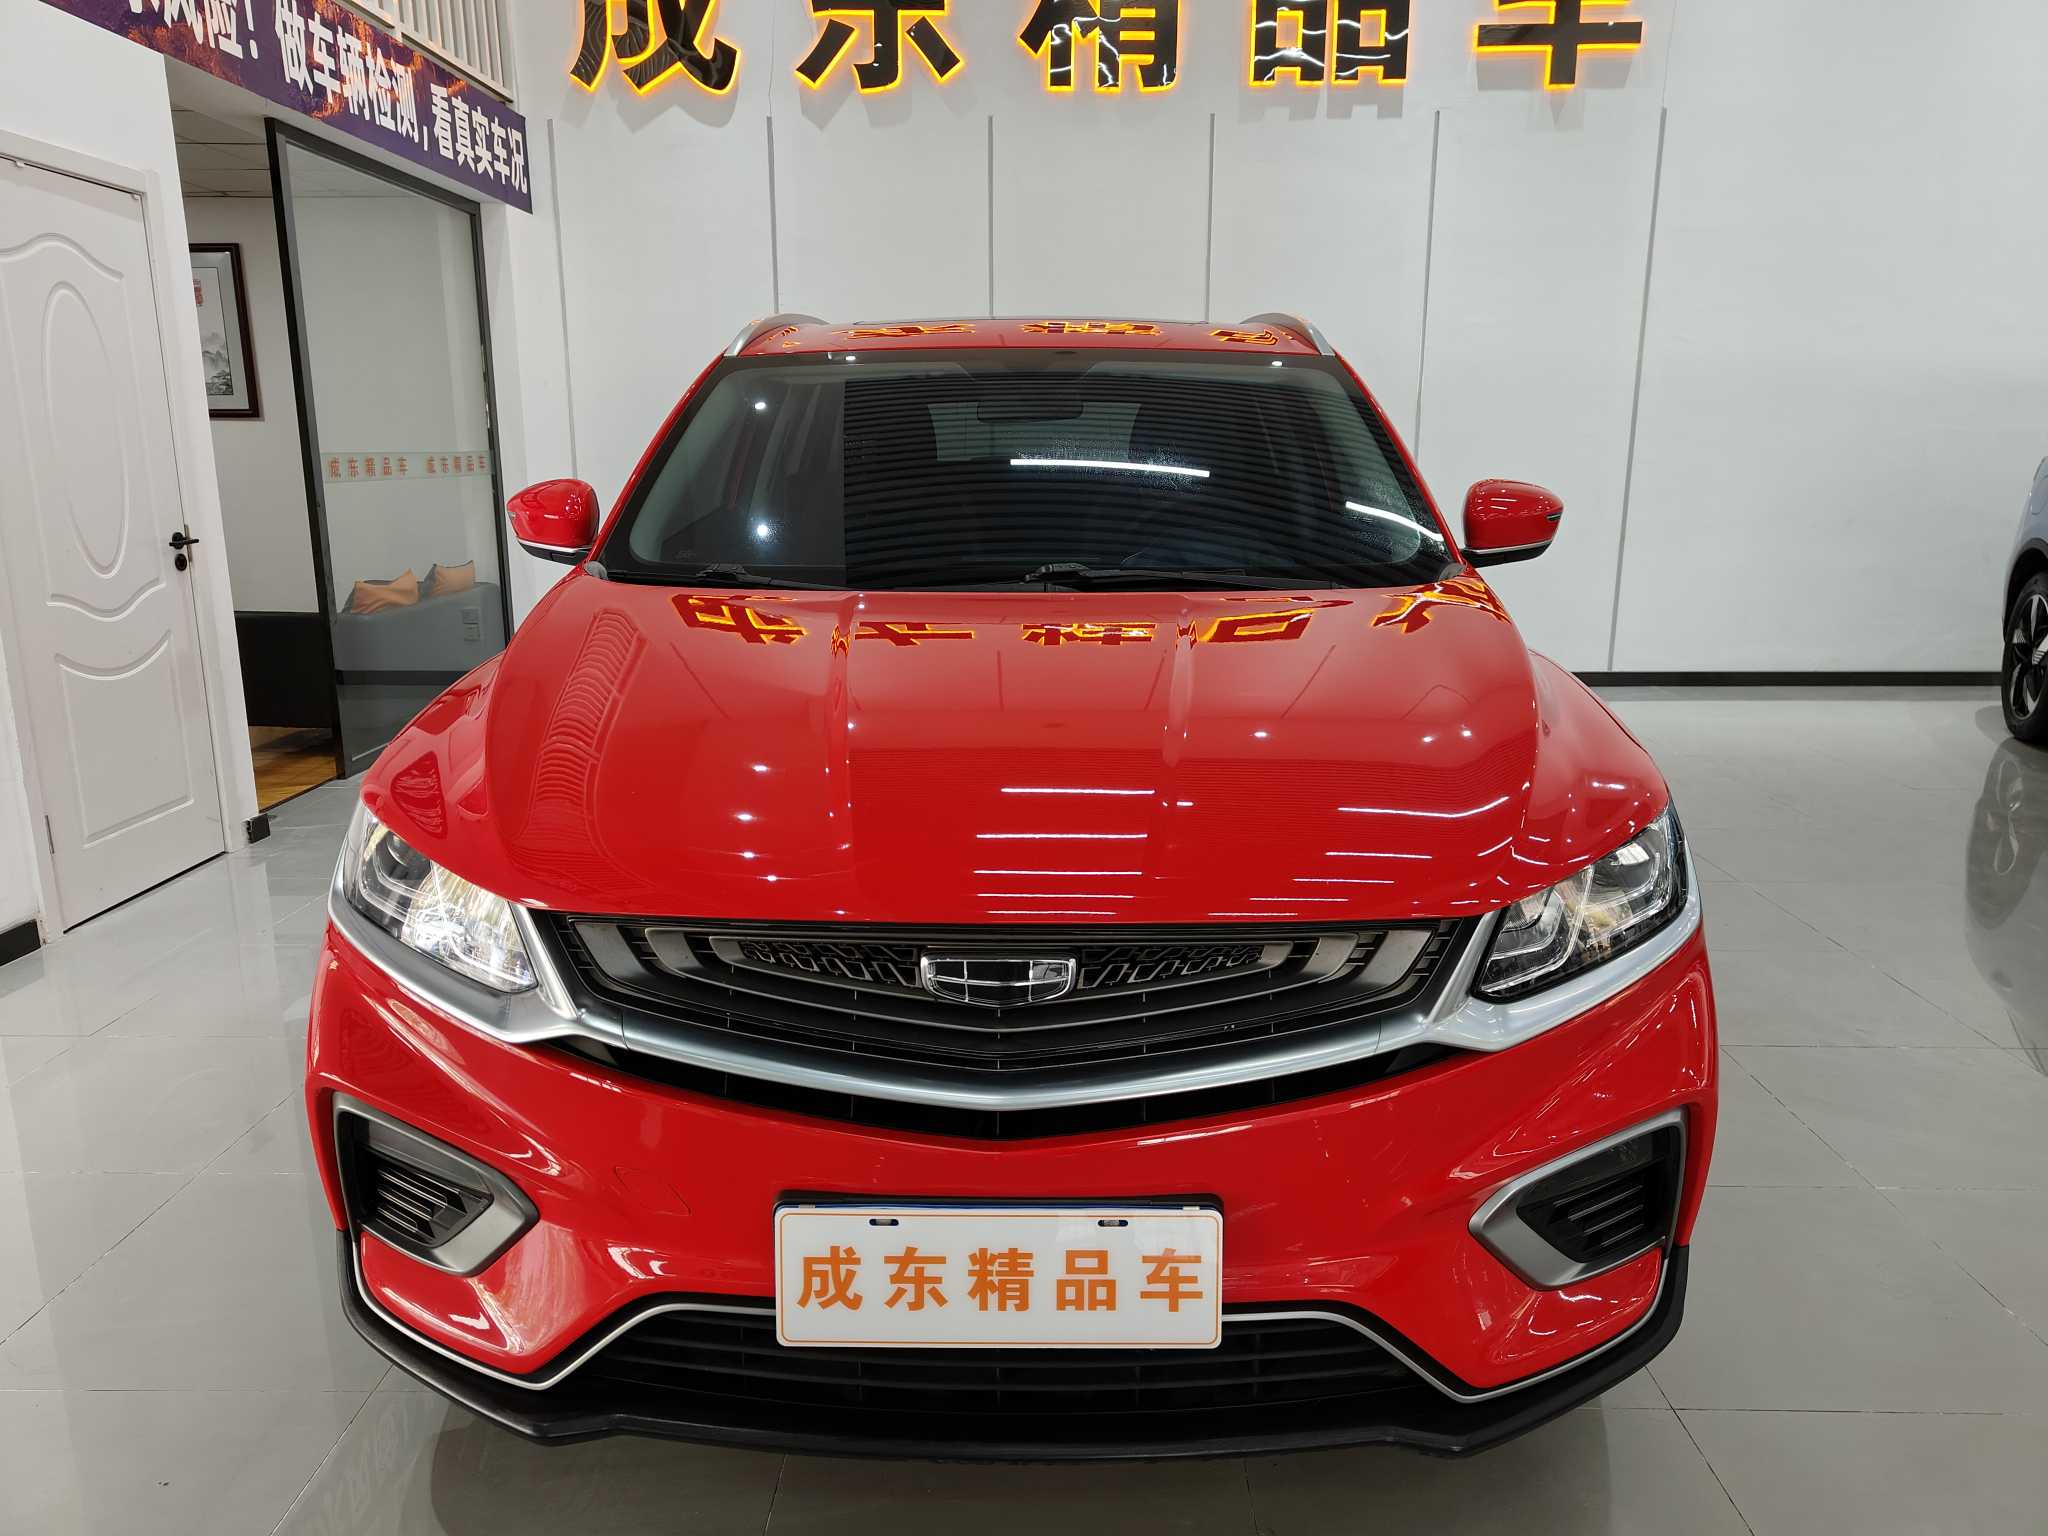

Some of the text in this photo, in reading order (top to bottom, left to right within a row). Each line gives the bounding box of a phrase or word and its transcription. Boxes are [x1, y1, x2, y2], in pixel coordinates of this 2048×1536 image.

[797, 1246, 1204, 1313] 成东精品车
